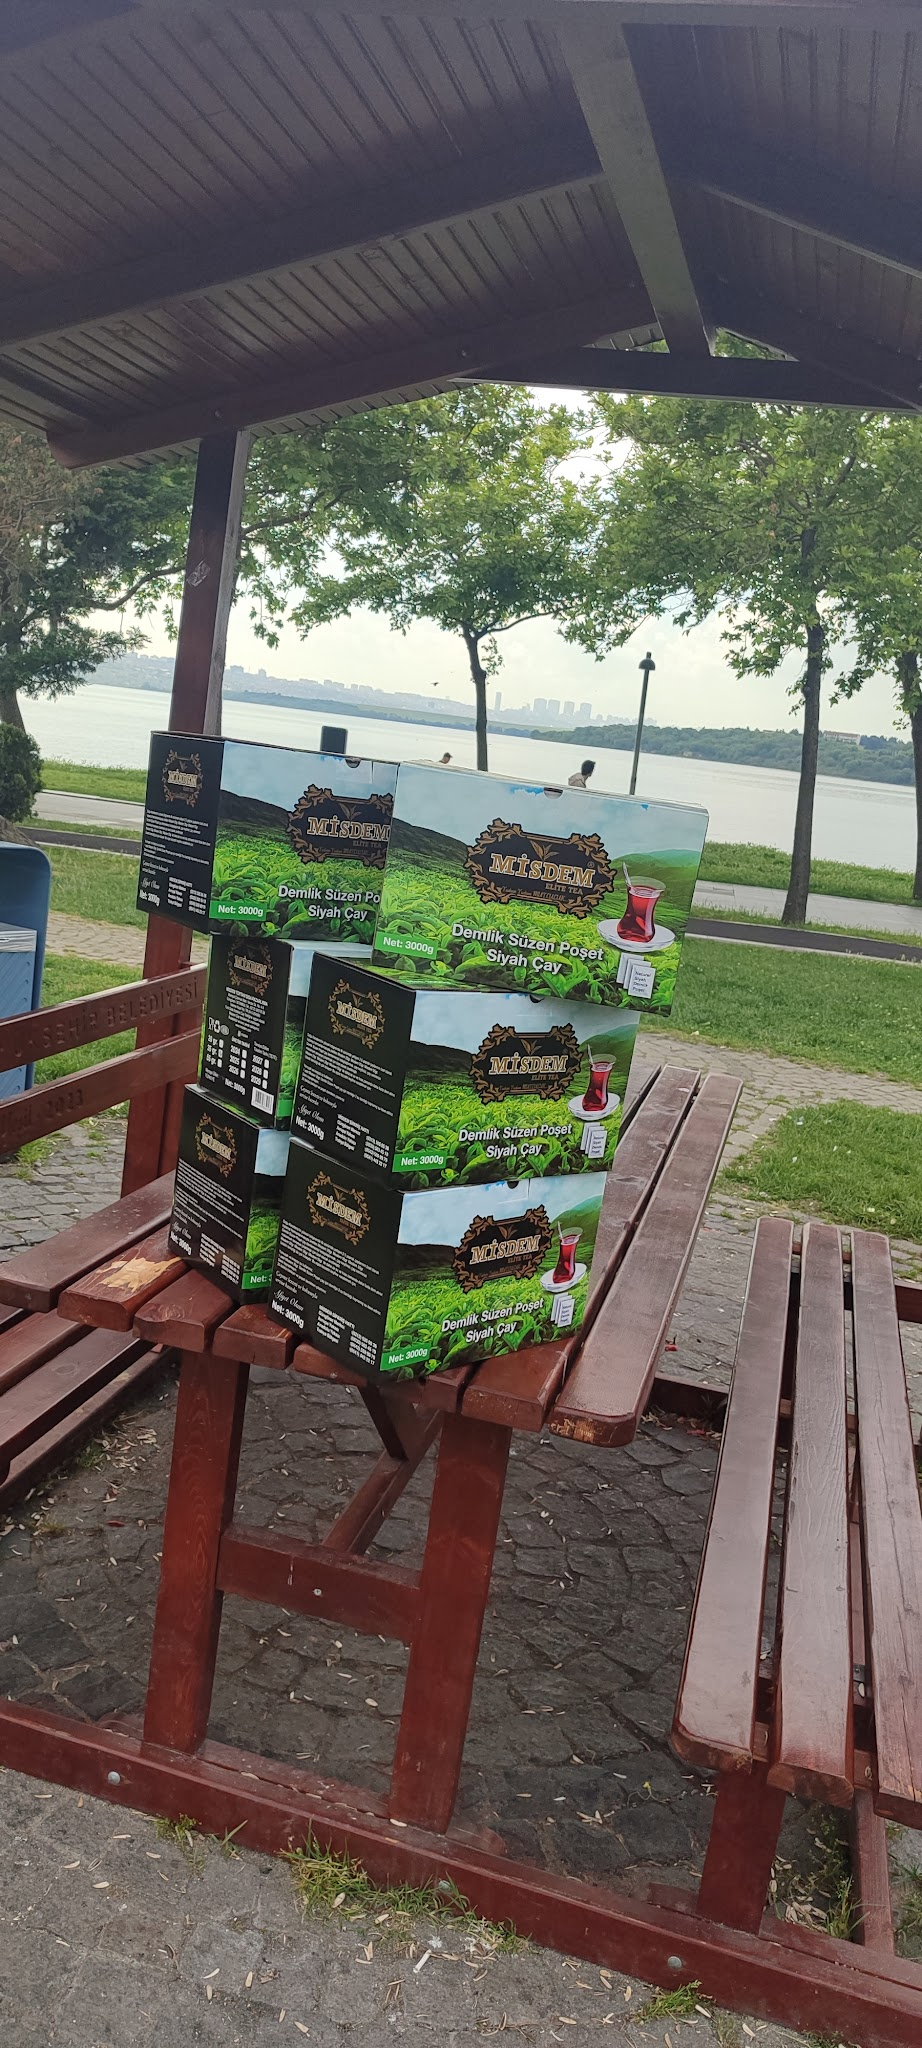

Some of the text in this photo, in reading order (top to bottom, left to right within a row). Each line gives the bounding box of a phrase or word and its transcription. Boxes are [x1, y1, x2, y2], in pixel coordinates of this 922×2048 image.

[307, 815, 391, 841] MİSDEM
[489, 853, 596, 888] MİSDEM
[278, 885, 322, 900] Demlik
[325, 888, 362, 902] Süzen
[568, 886, 584, 895] TEA
[218, 904, 263, 917] Net: 3000g
[308, 905, 368, 922] Siyah Çay
[383, 936, 434, 955] Net: 3000g
[452, 923, 604, 963] Demlik Süzen Poşet
[486, 949, 562, 975] Siyah Çay
[107, 981, 198, 1028] BELEDİYESİ
[489, 1052, 568, 1075] MİSDEM
[307, 1122, 325, 1140] 3000g
[459, 1123, 572, 1142] Demlik Süzen Poşet
[401, 1155, 444, 1166] Net: 3000g
[486, 1143, 542, 1159] Siyah Çay
[315, 1191, 362, 1227] MİSDEM
[469, 1234, 541, 1265] MİSDEM
[272, 1300, 285, 1315] Net:
[285, 1309, 304, 1328] 3000g
[441, 1314, 478, 1332] Demlik
[481, 1307, 513, 1323] Süzen
[515, 1298, 544, 1315] Poşet
[465, 1322, 517, 1343] Siyah Çay
[388, 1348, 428, 1364] Net: 3000g
